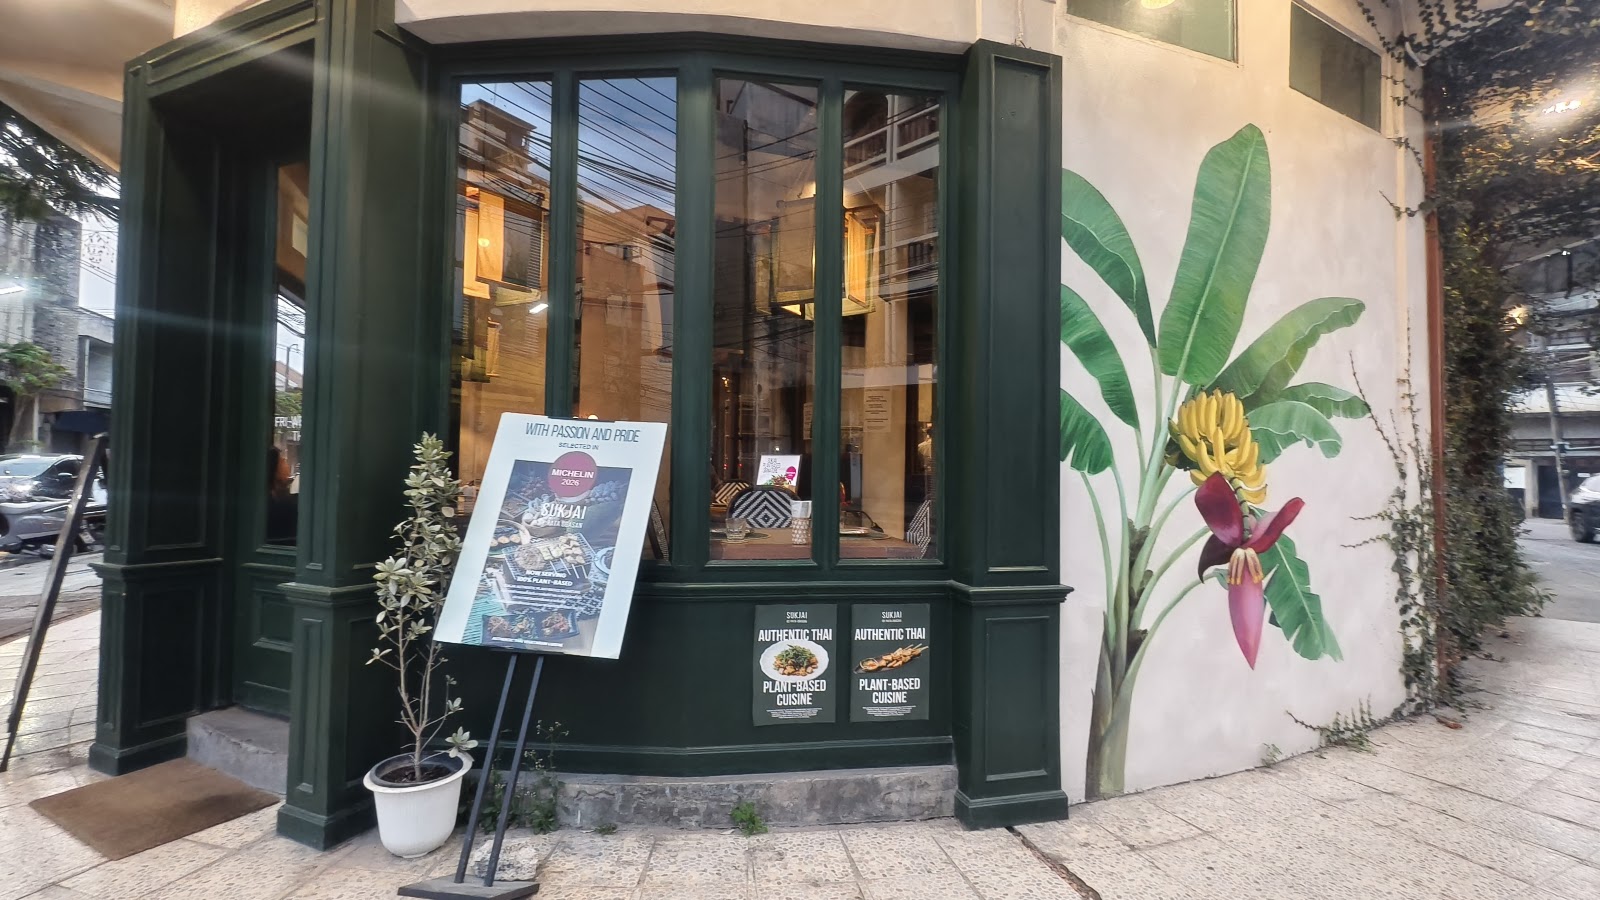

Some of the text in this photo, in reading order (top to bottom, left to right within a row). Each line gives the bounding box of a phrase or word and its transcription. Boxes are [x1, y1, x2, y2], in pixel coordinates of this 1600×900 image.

[526, 422, 641, 442] WITH PASSION AND PRIDE
[558, 442, 592, 450] SELECTED
[552, 468, 594, 478] MICHELIN
[560, 478, 580, 486] 2026
[540, 502, 587, 520] SUKJAI
[533, 578, 573, 586] PLANT-BASED
[786, 612, 808, 620] SUKJAI
[882, 610, 902, 619] SUKJAI
[758, 628, 832, 642] AUTHENTIC THAI
[854, 627, 926, 641] AUTHENTIC THAI
[763, 680, 827, 694] PLANT-BASED
[859, 678, 921, 691] PLANT-BASED
[776, 692, 812, 706] CUISINE
[872, 692, 907, 704] CUISINE
